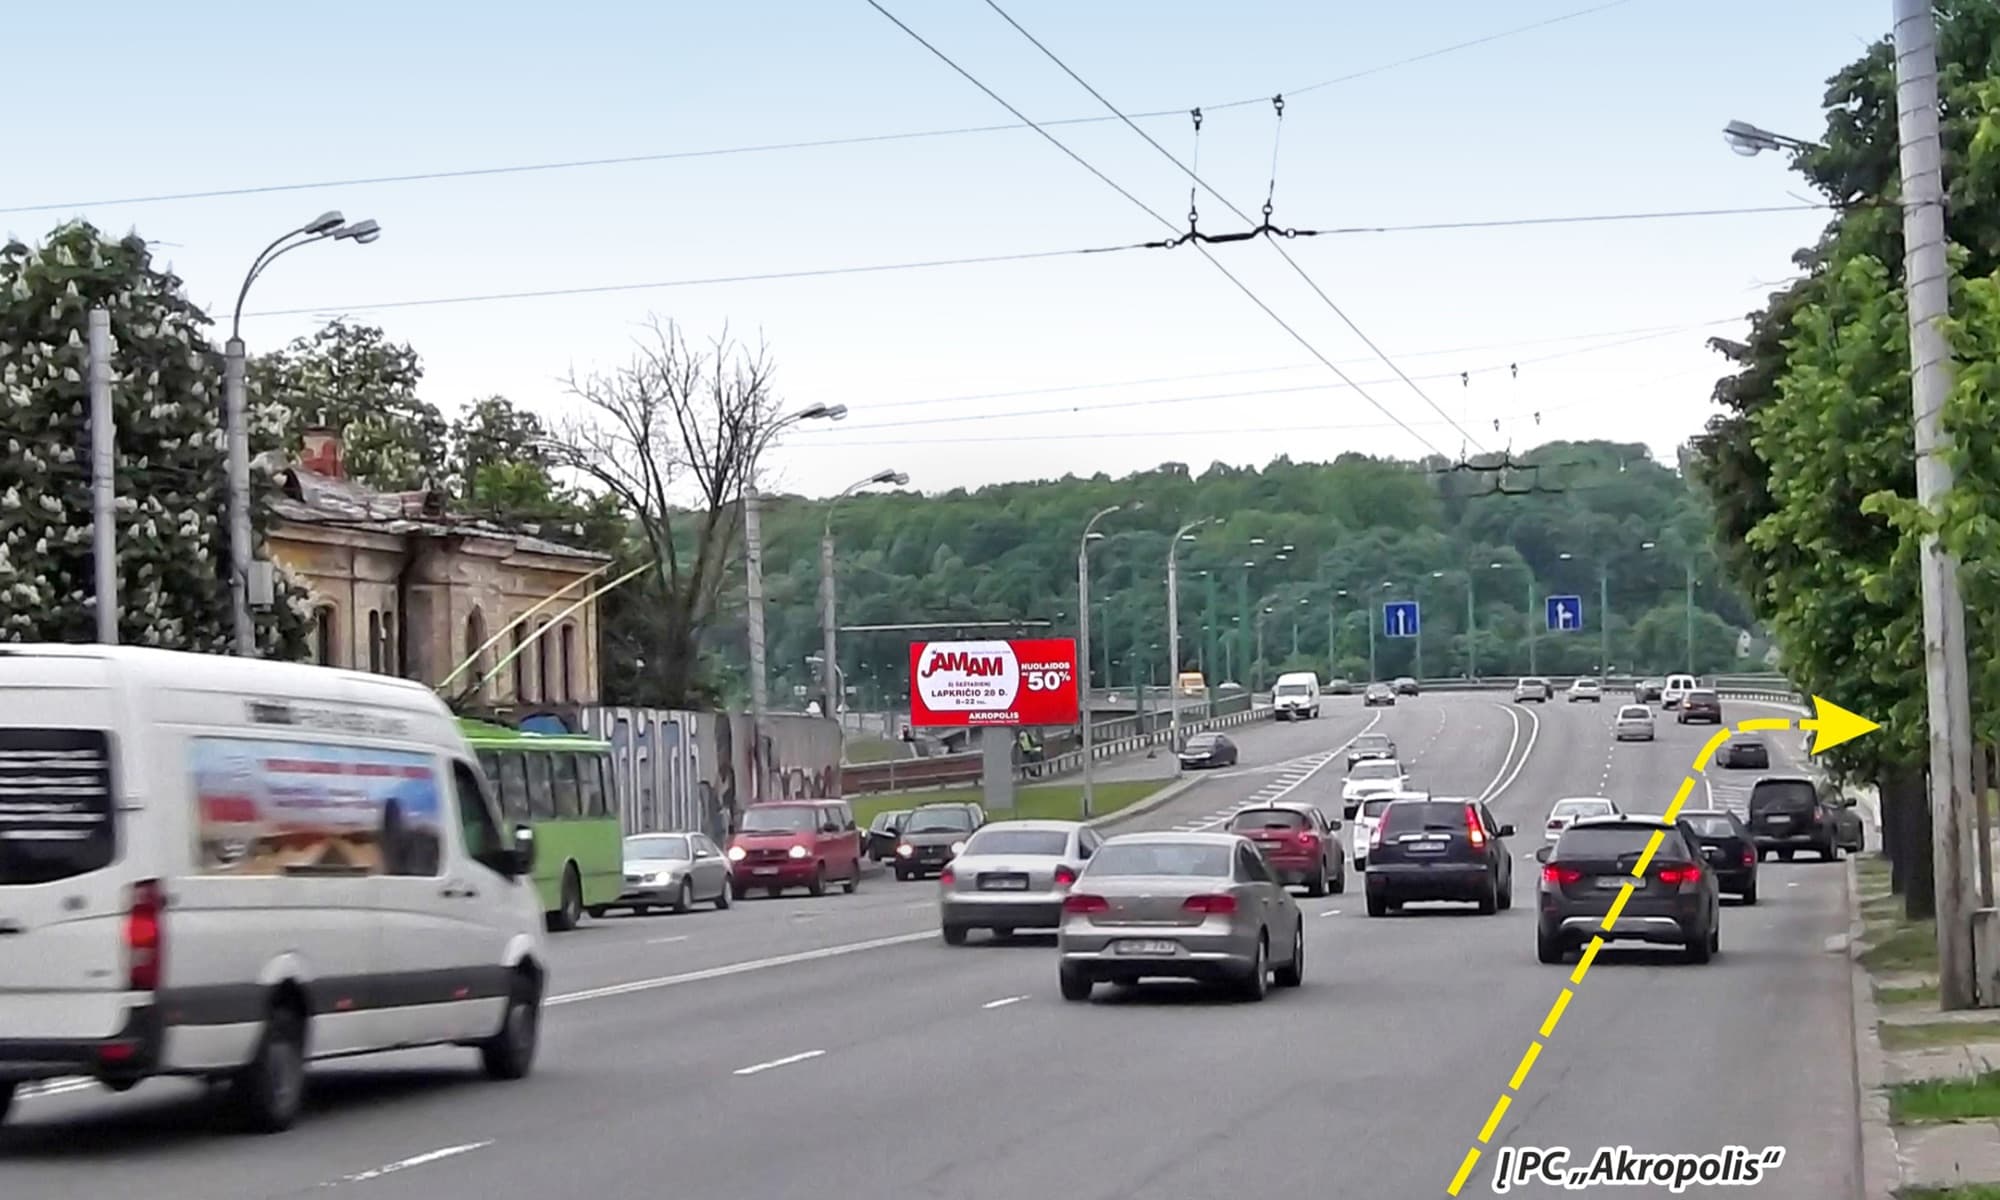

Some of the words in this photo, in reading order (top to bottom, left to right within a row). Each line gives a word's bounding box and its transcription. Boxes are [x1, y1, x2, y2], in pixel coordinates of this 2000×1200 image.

[1021, 662, 1070, 671] NUOLAIDOS
[1028, 671, 1071, 691] 50%
[931, 688, 981, 697] LAPKRIČIO
[968, 712, 1019, 720] AKROPOLIS
